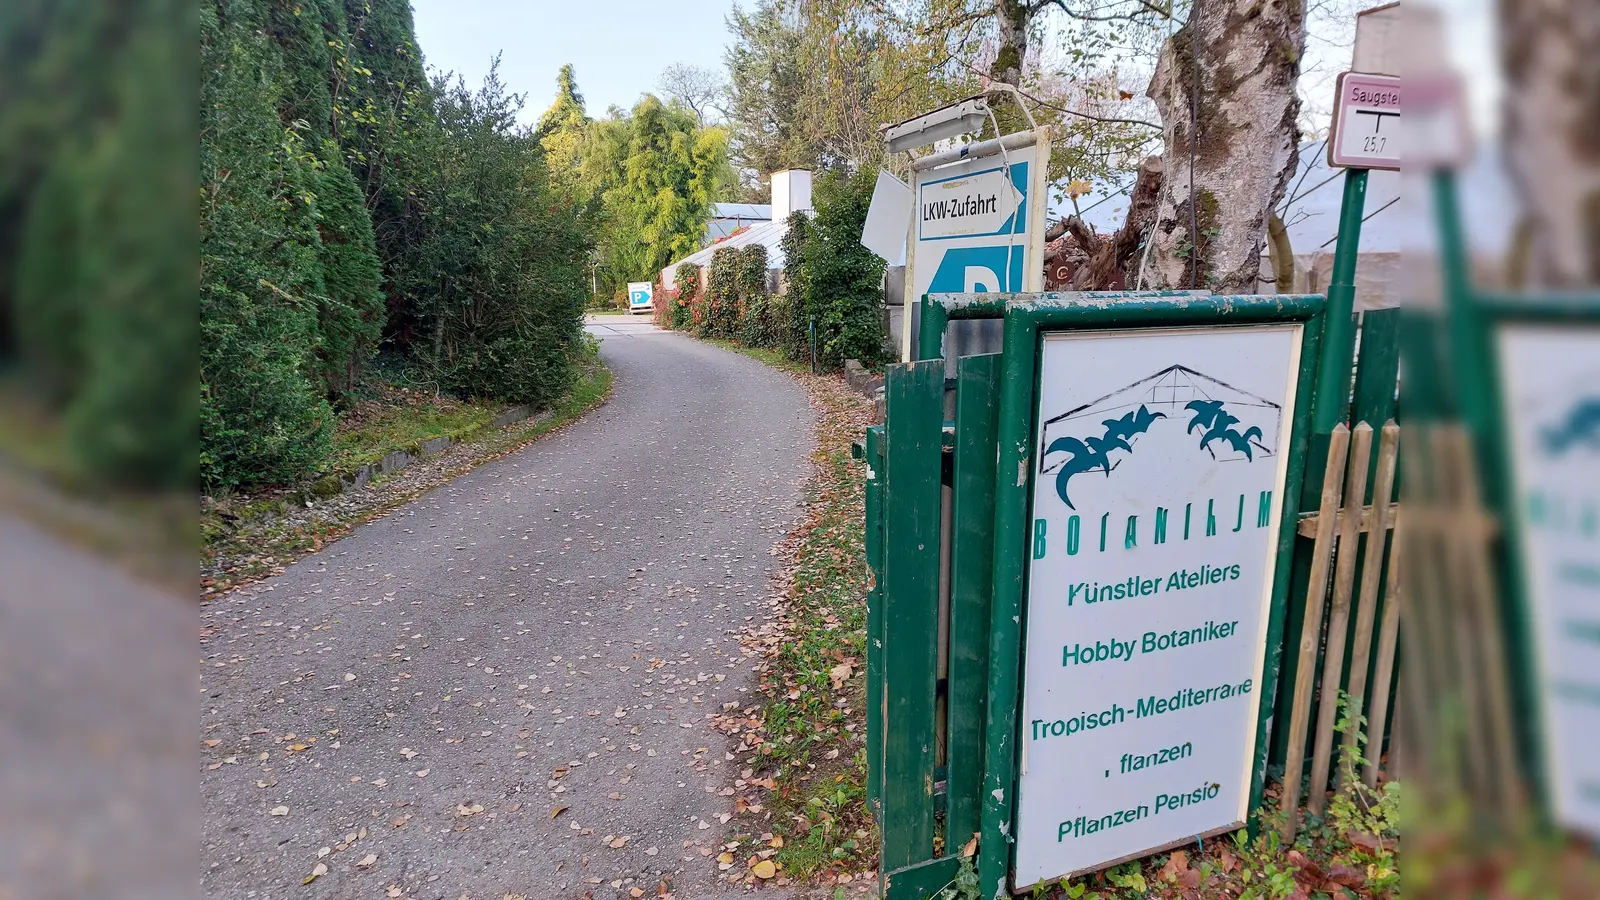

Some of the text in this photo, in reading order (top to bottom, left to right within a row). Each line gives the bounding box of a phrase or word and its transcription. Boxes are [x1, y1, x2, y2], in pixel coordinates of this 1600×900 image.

[923, 193, 997, 221] LKW-Zufahrt
[634, 292, 642, 302] P
[1068, 564, 1240, 606] Künstler Ateliers
[1062, 620, 1238, 667] Hobby Botaniker
[1057, 805, 1148, 842] Pflanzen
